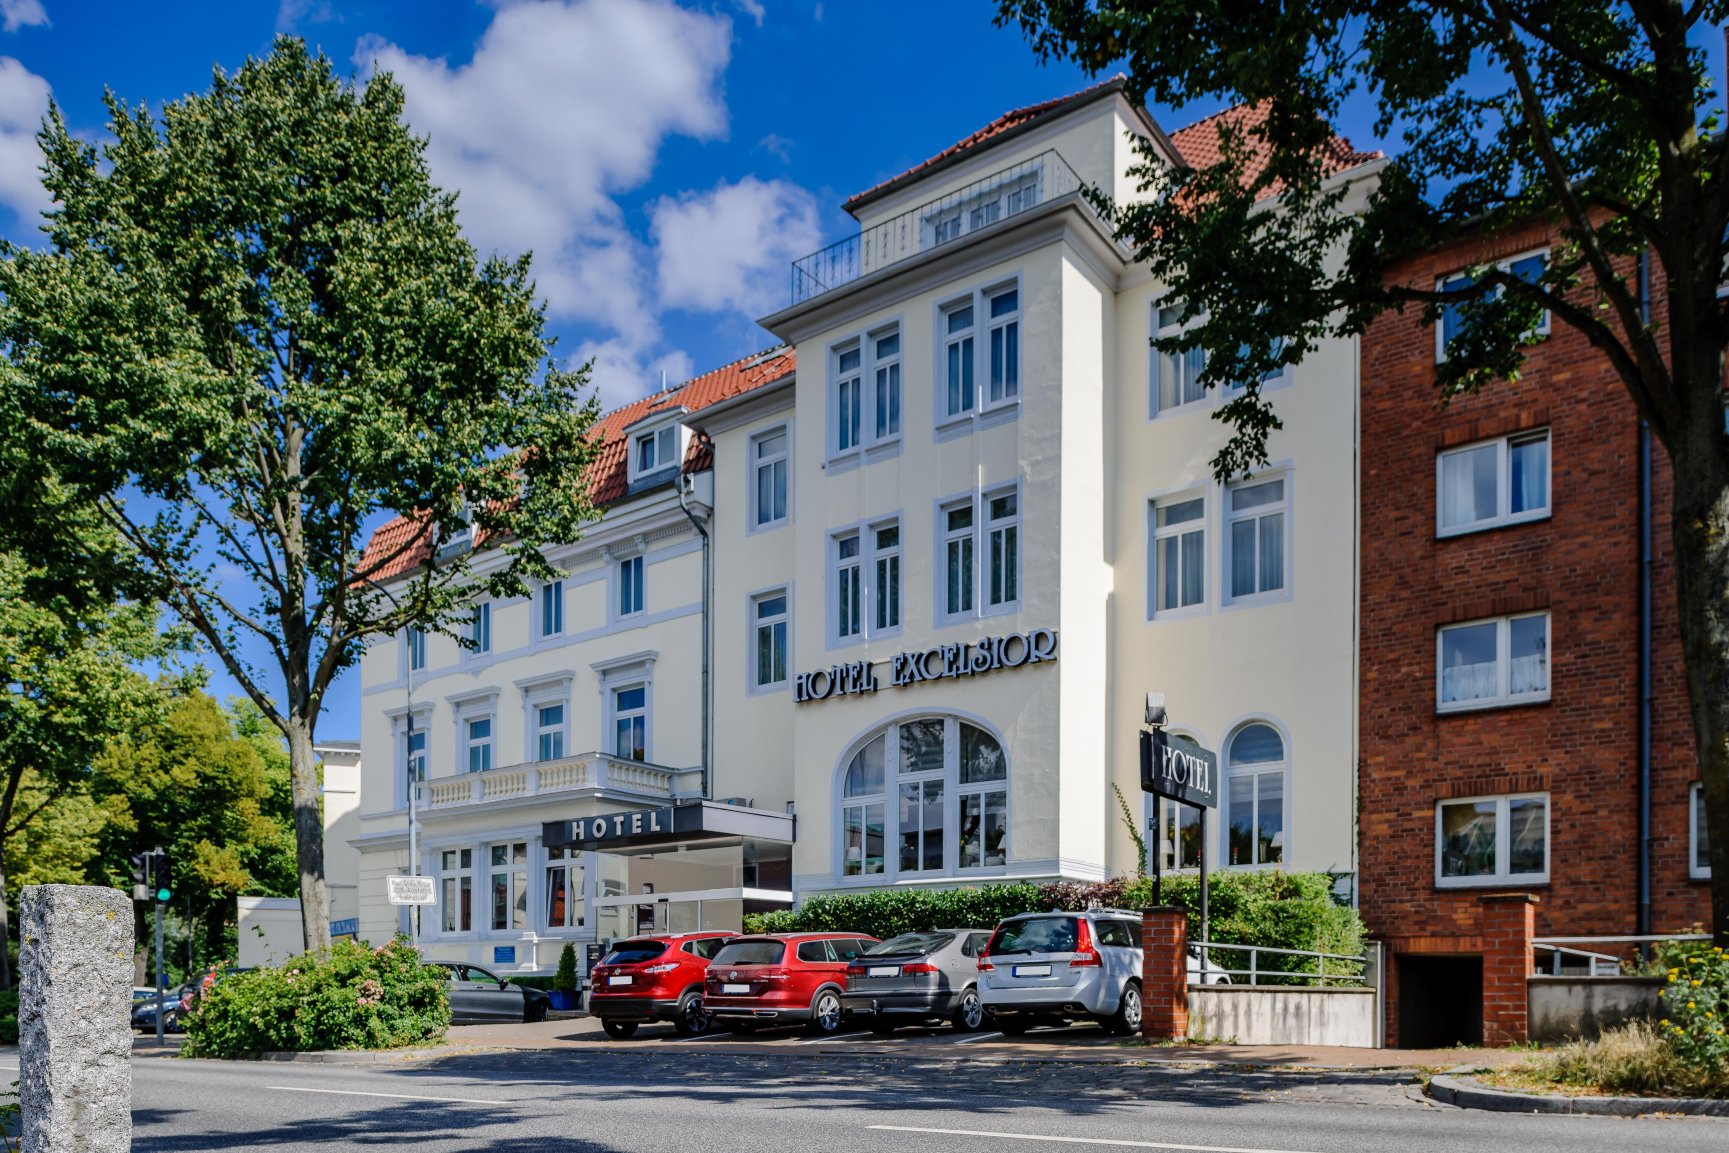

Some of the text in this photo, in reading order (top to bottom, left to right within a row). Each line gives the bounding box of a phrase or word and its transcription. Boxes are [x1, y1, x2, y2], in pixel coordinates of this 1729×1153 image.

[792, 628, 1057, 703] HOTEL EXCELSIOR
[1161, 744, 1212, 794] HOTEL
[572, 812, 661, 841] HOTEL
